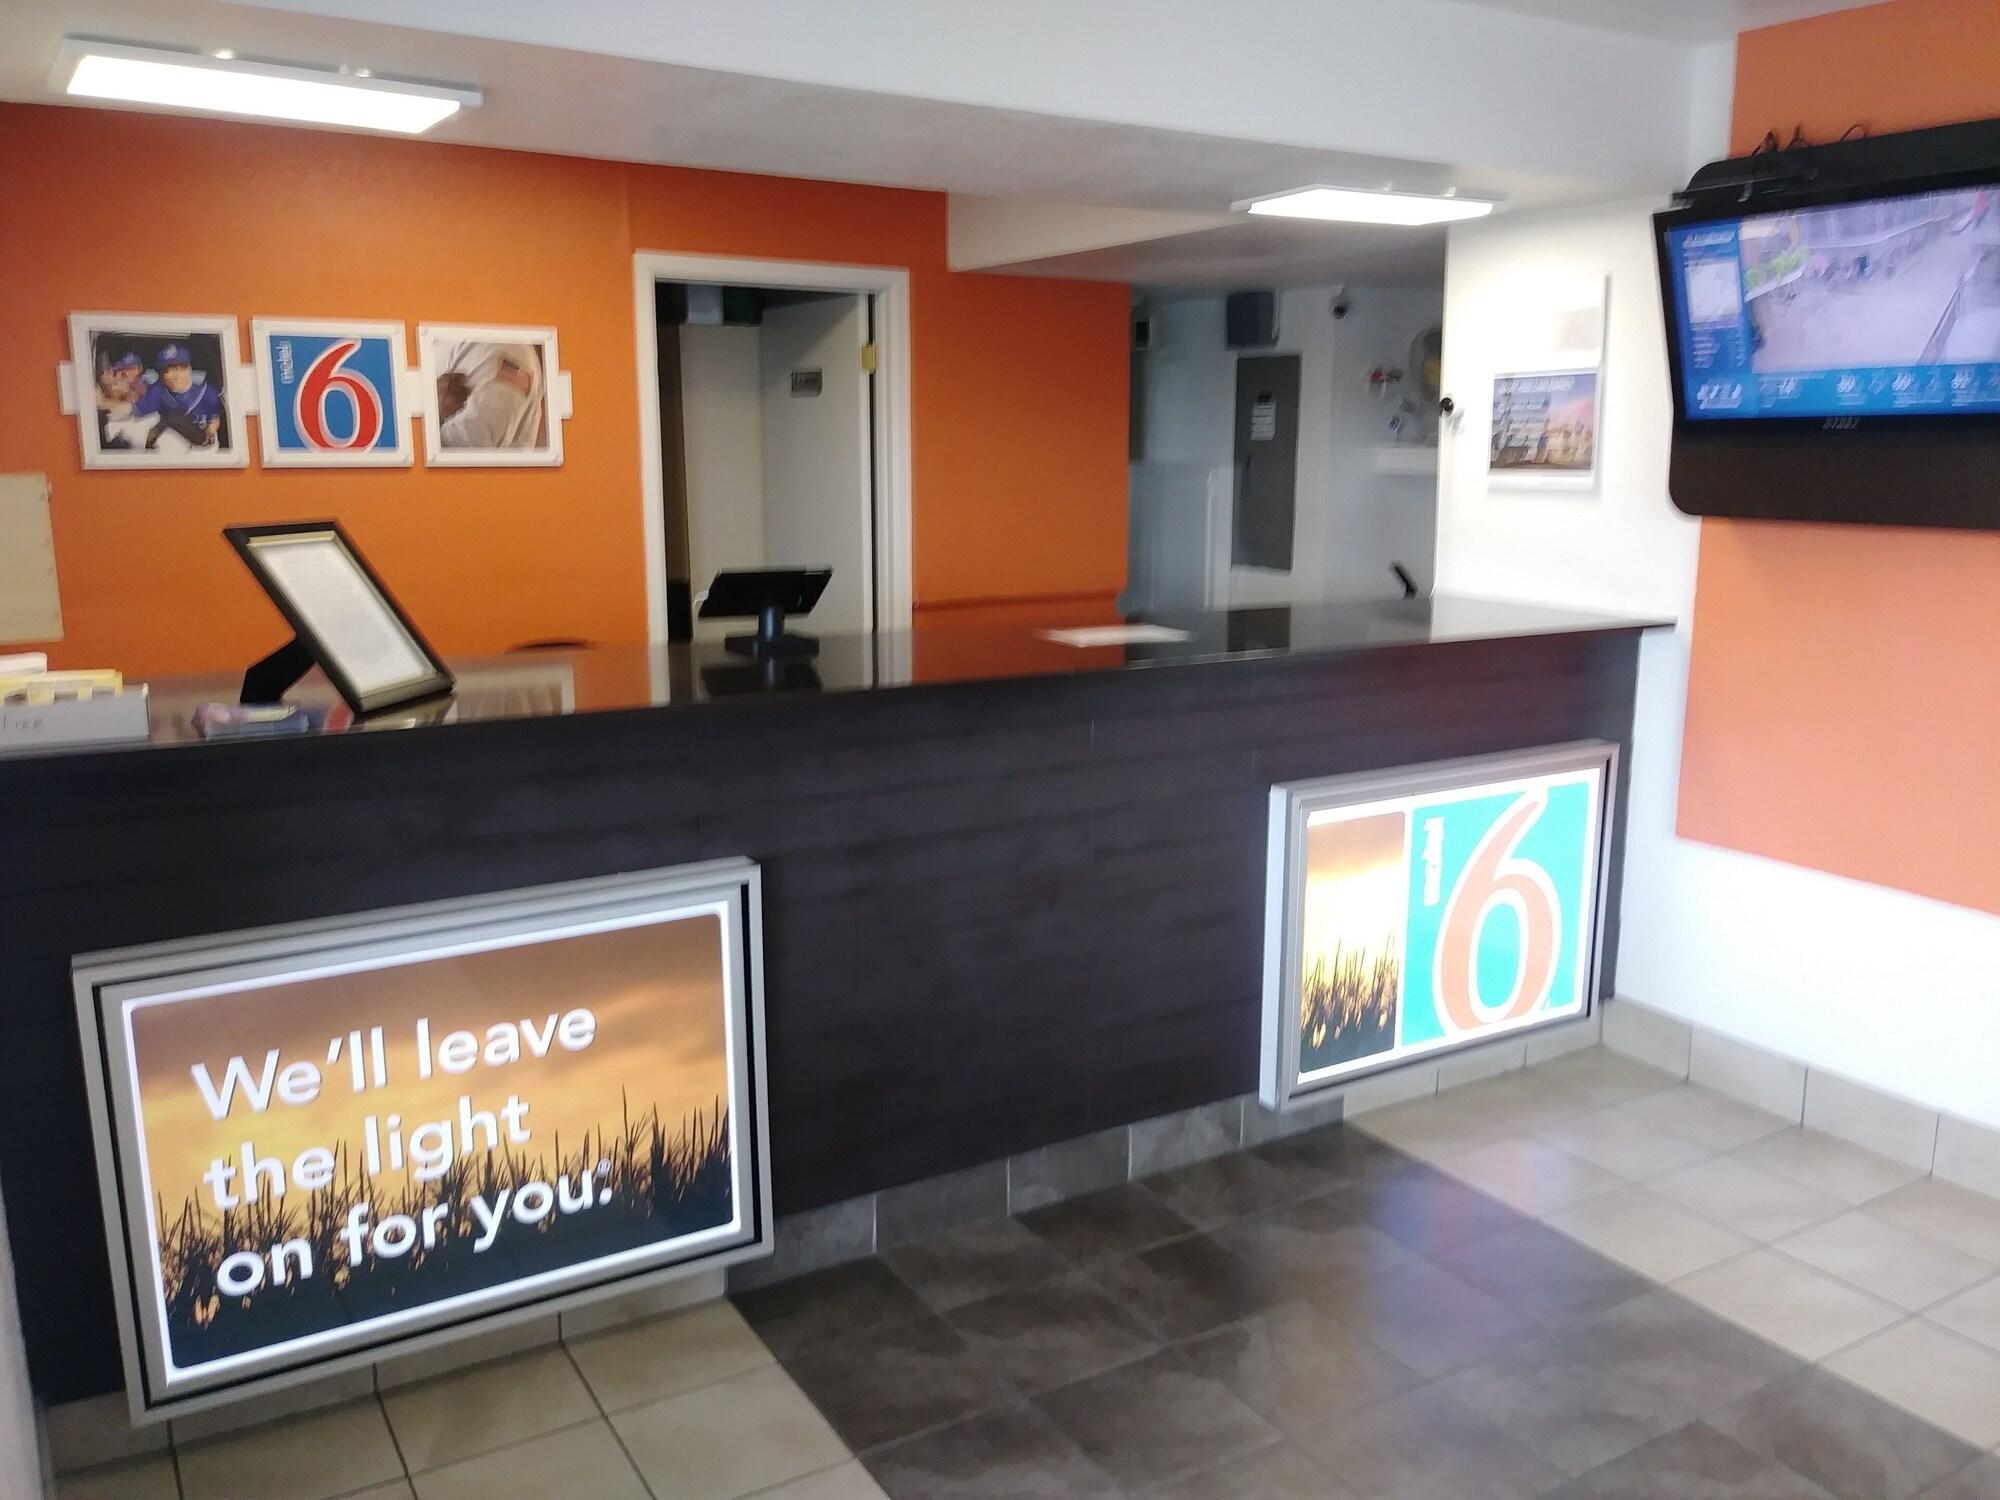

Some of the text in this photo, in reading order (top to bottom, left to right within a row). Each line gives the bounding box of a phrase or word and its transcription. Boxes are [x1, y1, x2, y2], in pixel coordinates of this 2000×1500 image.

[296, 340, 382, 451] 6
[1434, 791, 1561, 1033] 6
[416, 1007, 597, 1080] leave
[203, 1095, 532, 1210] the light
[216, 1238, 315, 1296] on
[340, 1202, 449, 1268] for
